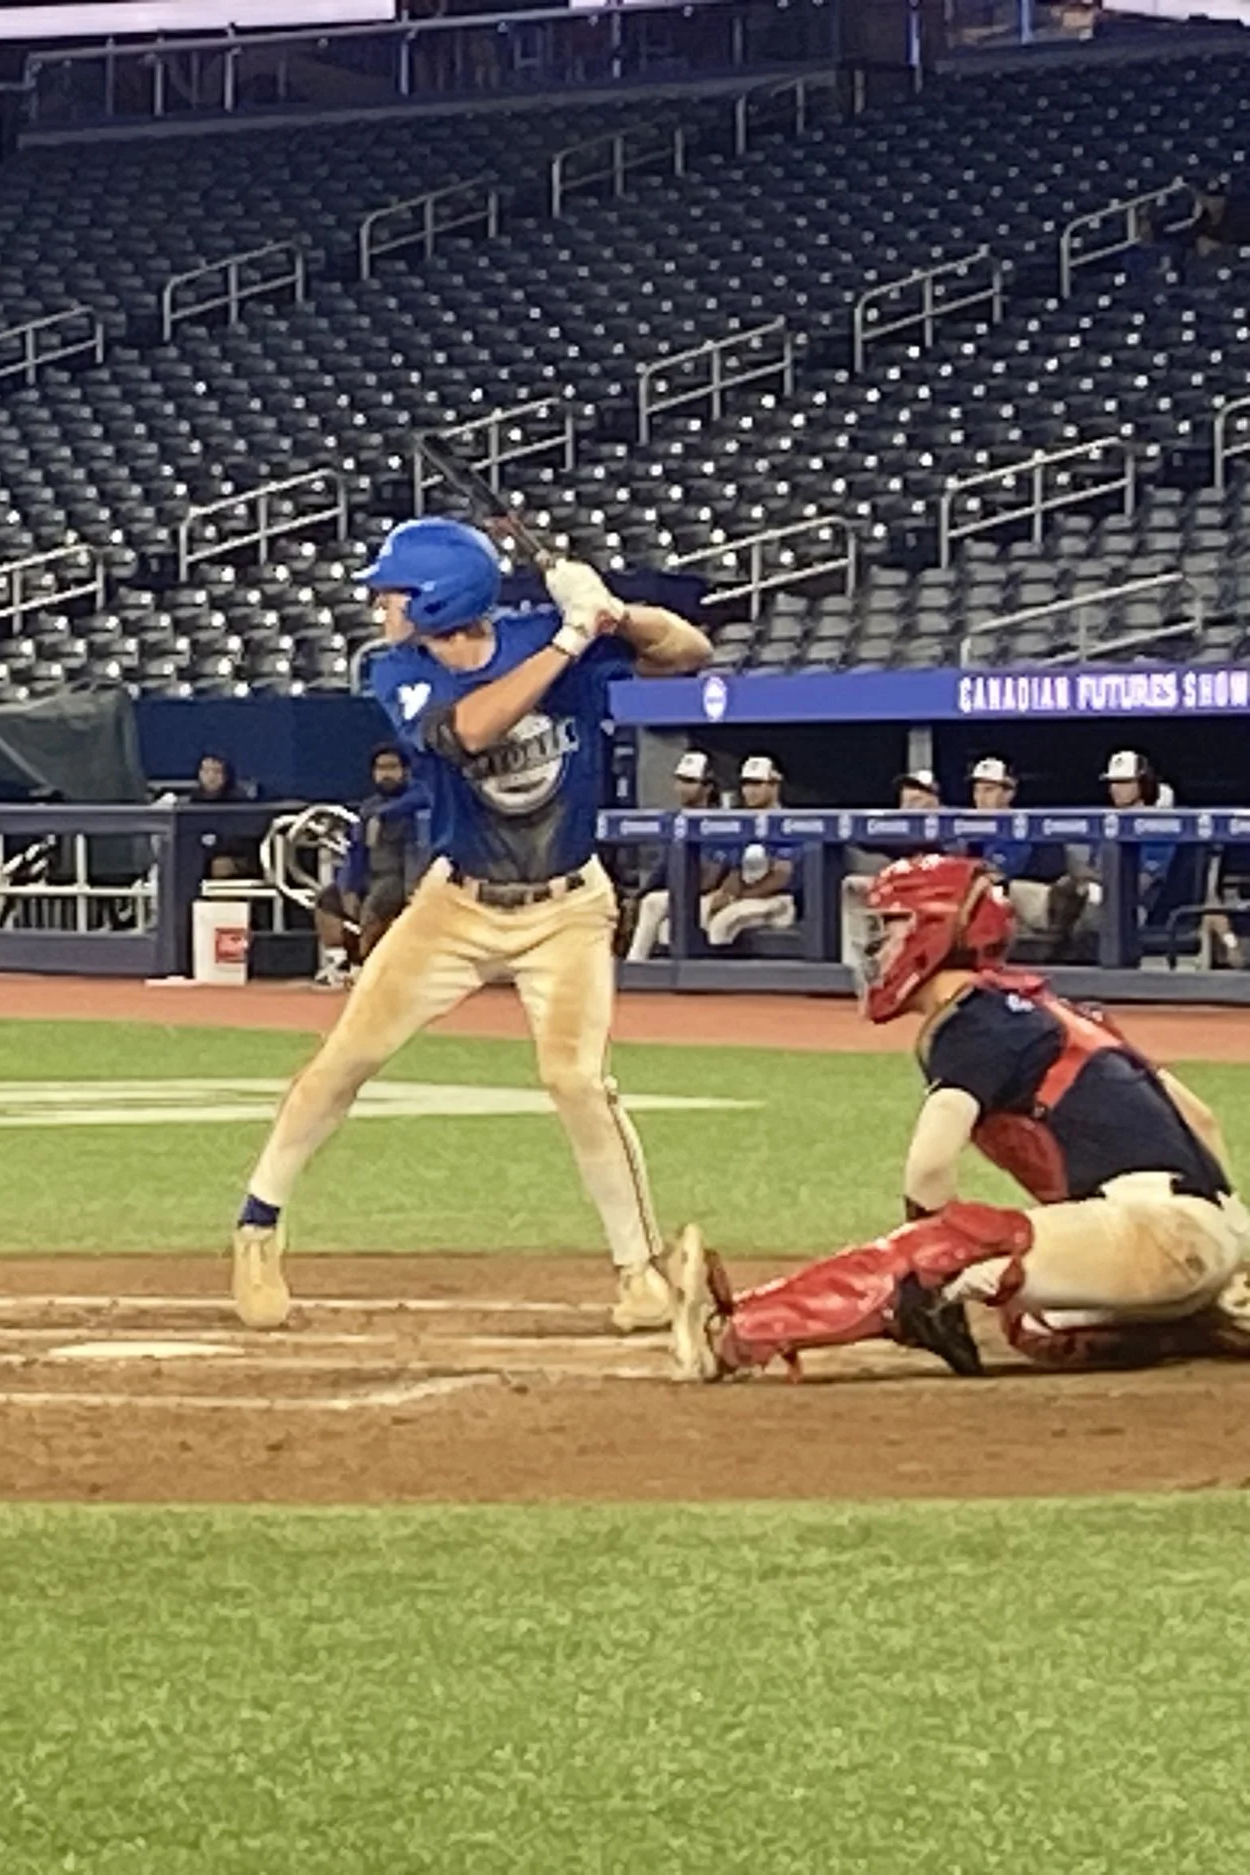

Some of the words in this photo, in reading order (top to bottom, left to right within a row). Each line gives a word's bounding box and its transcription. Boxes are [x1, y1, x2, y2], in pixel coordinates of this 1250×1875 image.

[959, 675, 1069, 713] CANADIAN
[1076, 672, 1178, 710] FUTURES
[1183, 670, 1248, 708] SHOW
